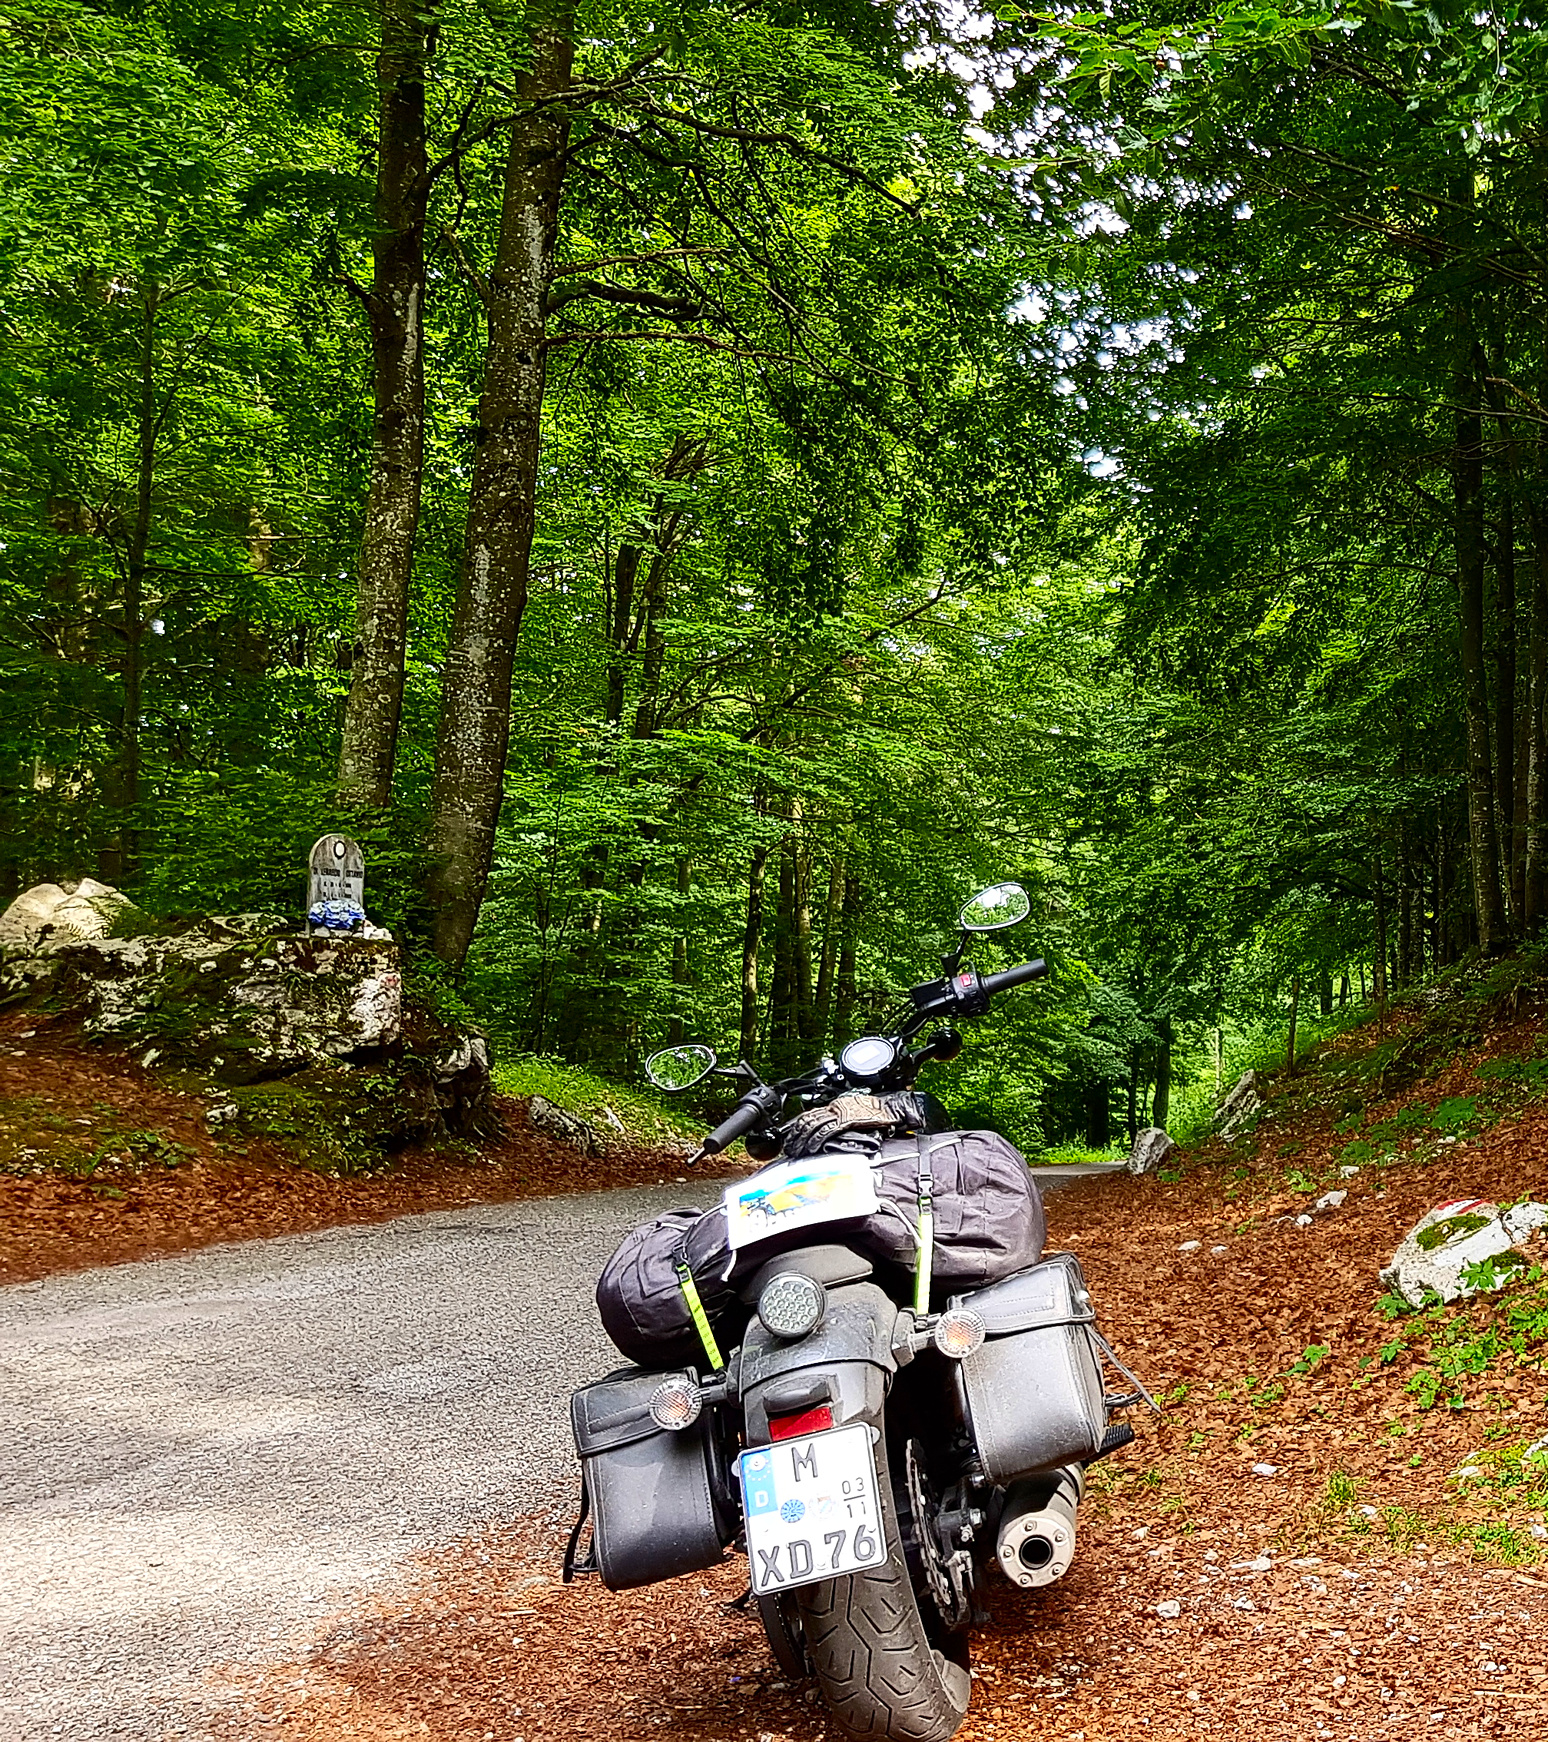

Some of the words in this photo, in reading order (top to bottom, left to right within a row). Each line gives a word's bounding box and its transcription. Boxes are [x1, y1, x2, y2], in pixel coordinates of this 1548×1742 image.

[791, 1443, 819, 1482] M
[842, 1476, 865, 1495] 03
[754, 1490, 769, 1508] D
[846, 1501, 867, 1518] 11
[758, 1538, 814, 1587] XD
[823, 1524, 877, 1570] 76
